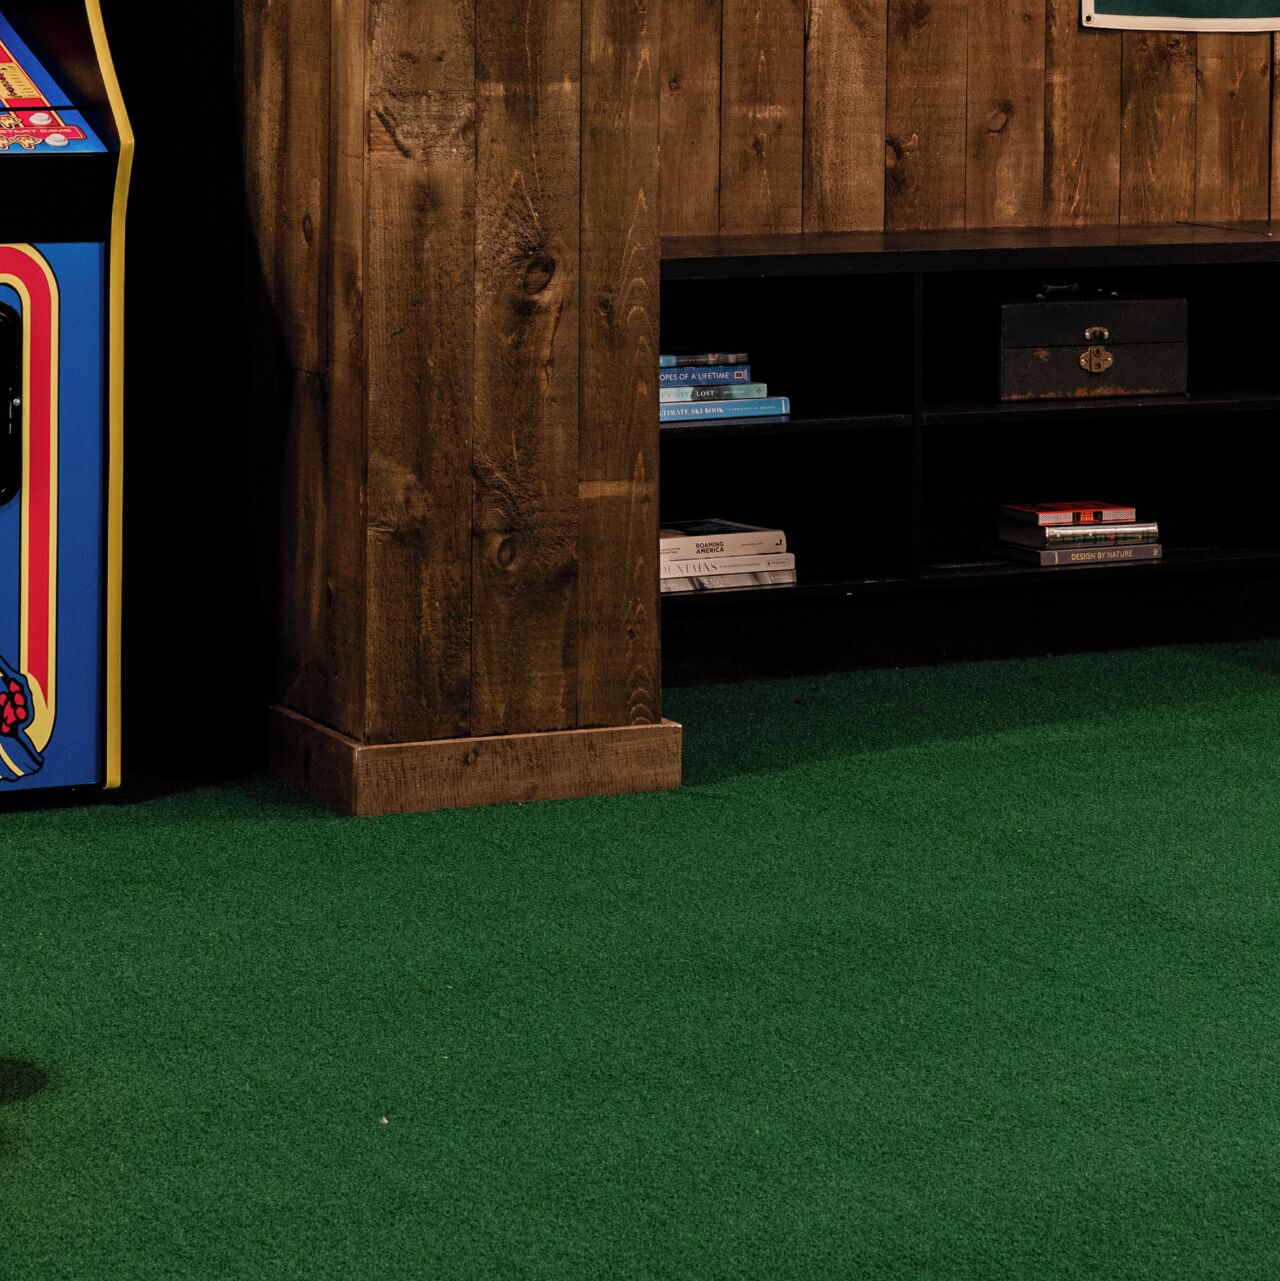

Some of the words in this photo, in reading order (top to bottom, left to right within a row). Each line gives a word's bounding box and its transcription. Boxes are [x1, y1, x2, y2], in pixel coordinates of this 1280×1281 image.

[698, 371, 730, 380] LIFETIME
[1071, 552, 1096, 561] DESIGN
[1097, 551, 1106, 559] BY
[1107, 550, 1133, 558] NATURE
